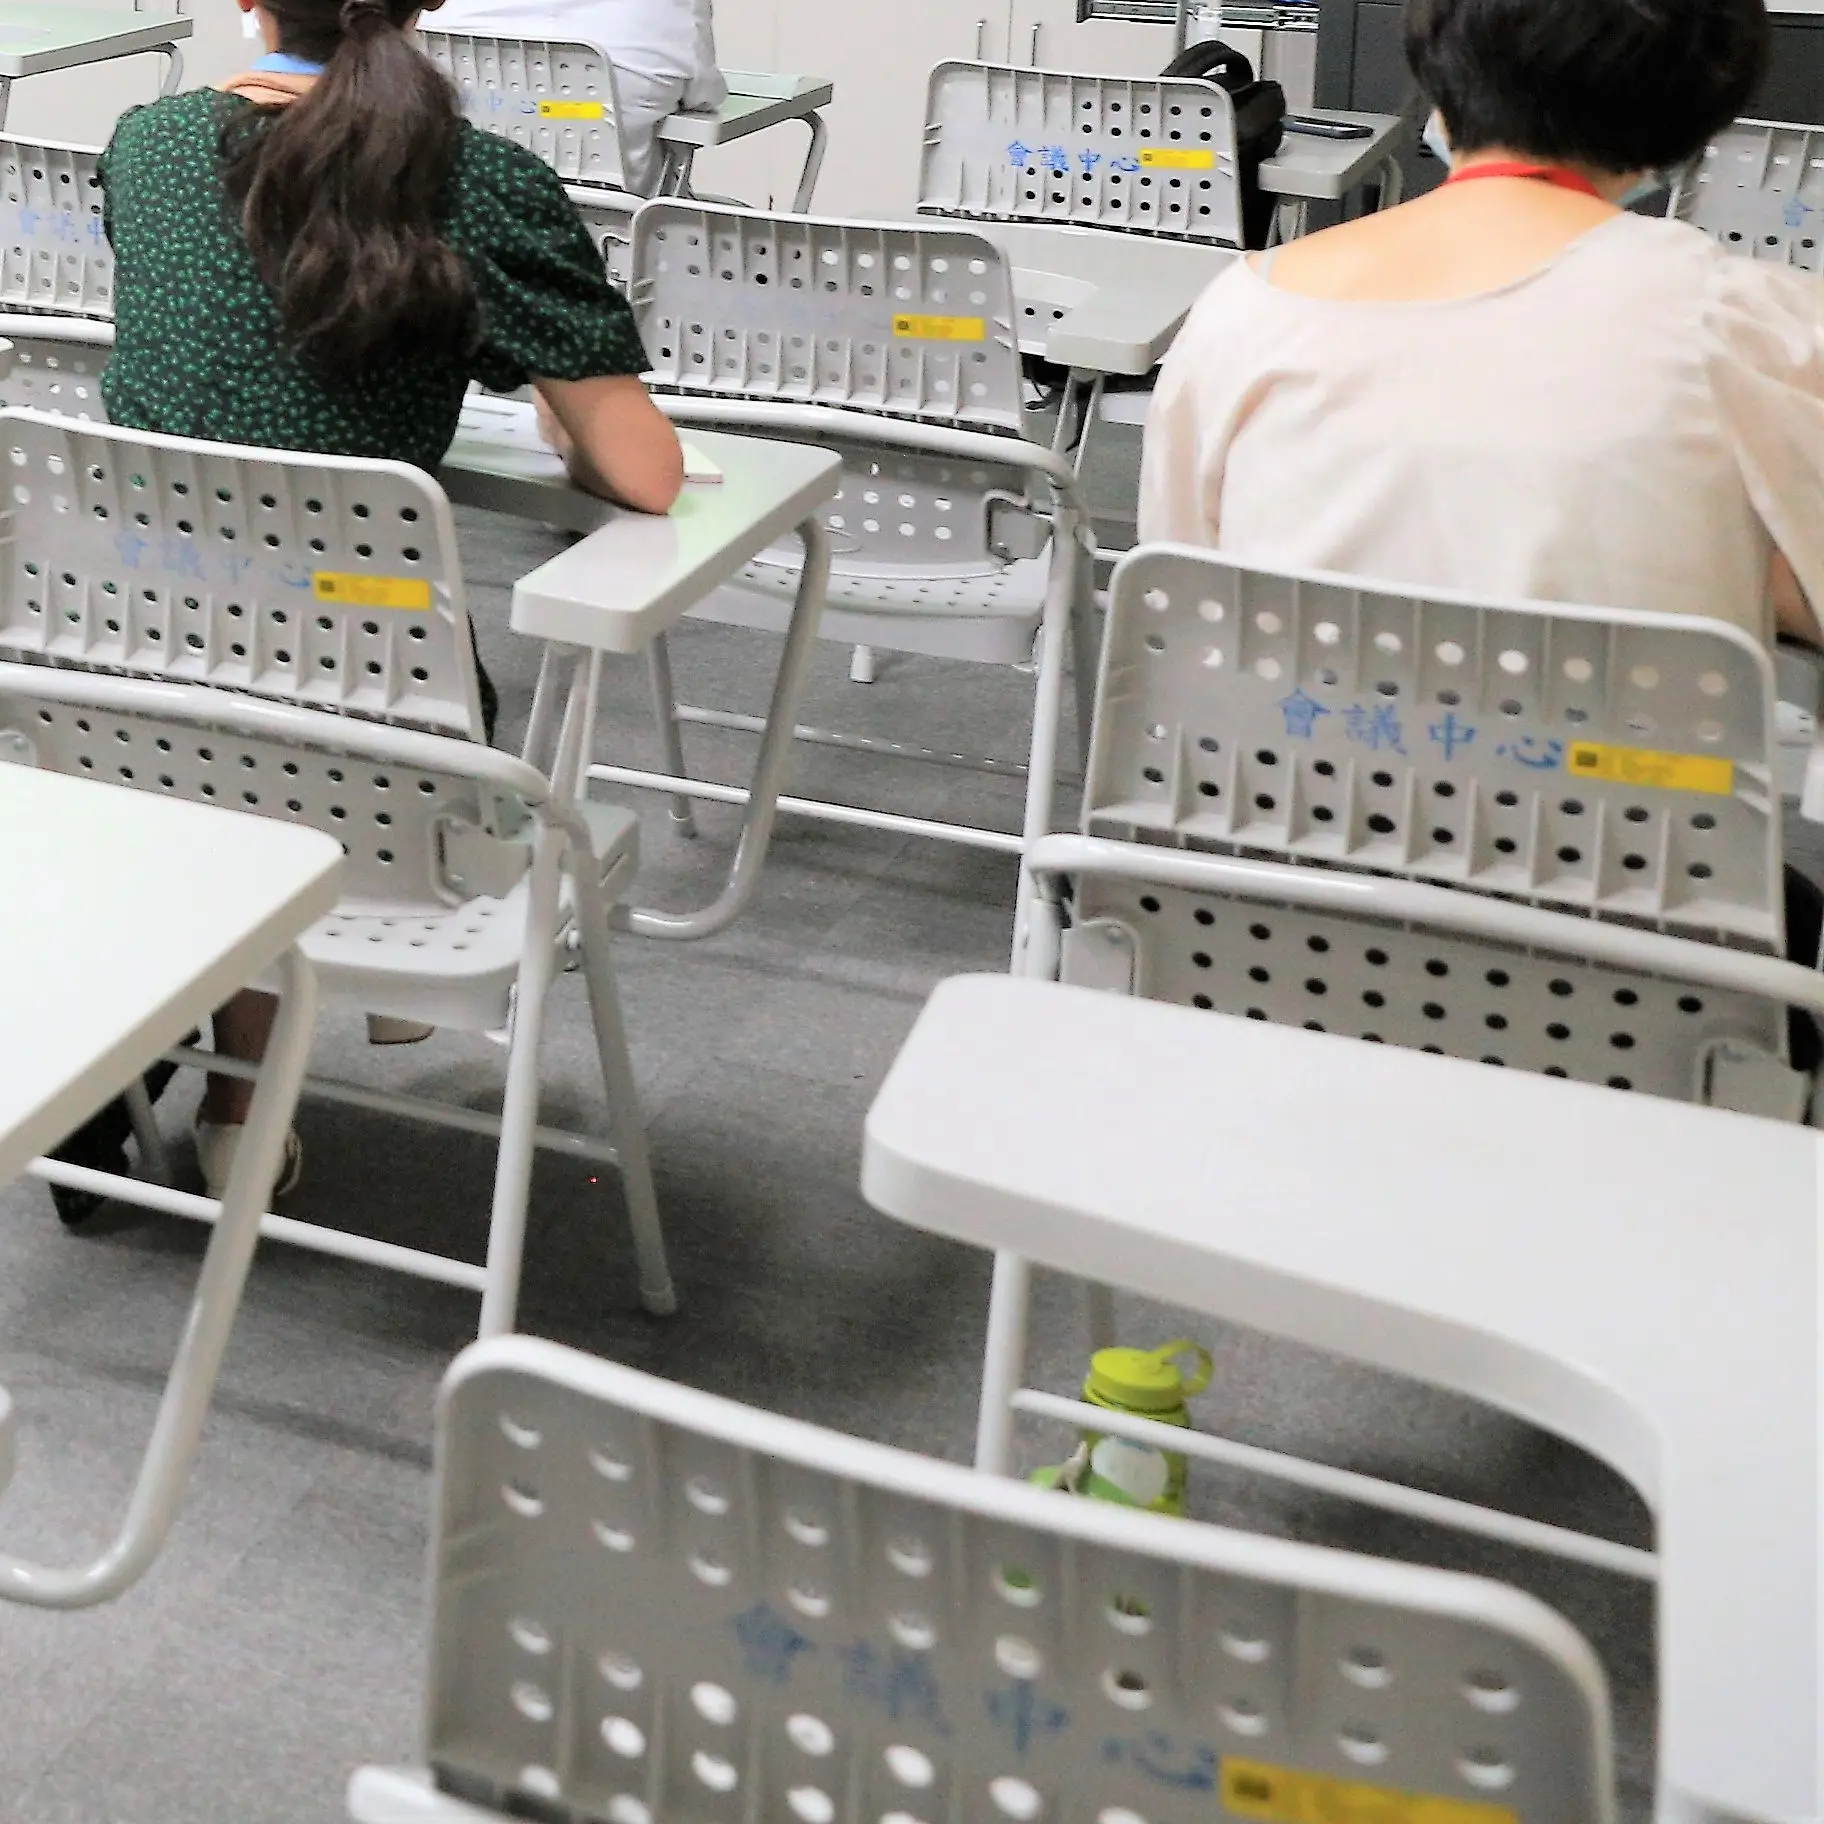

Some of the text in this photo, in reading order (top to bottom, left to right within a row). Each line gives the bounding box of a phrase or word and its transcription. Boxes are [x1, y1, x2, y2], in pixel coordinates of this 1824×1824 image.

[1008, 140, 1141, 172] 會議中心
[1279, 688, 1564, 769] 會議中心
